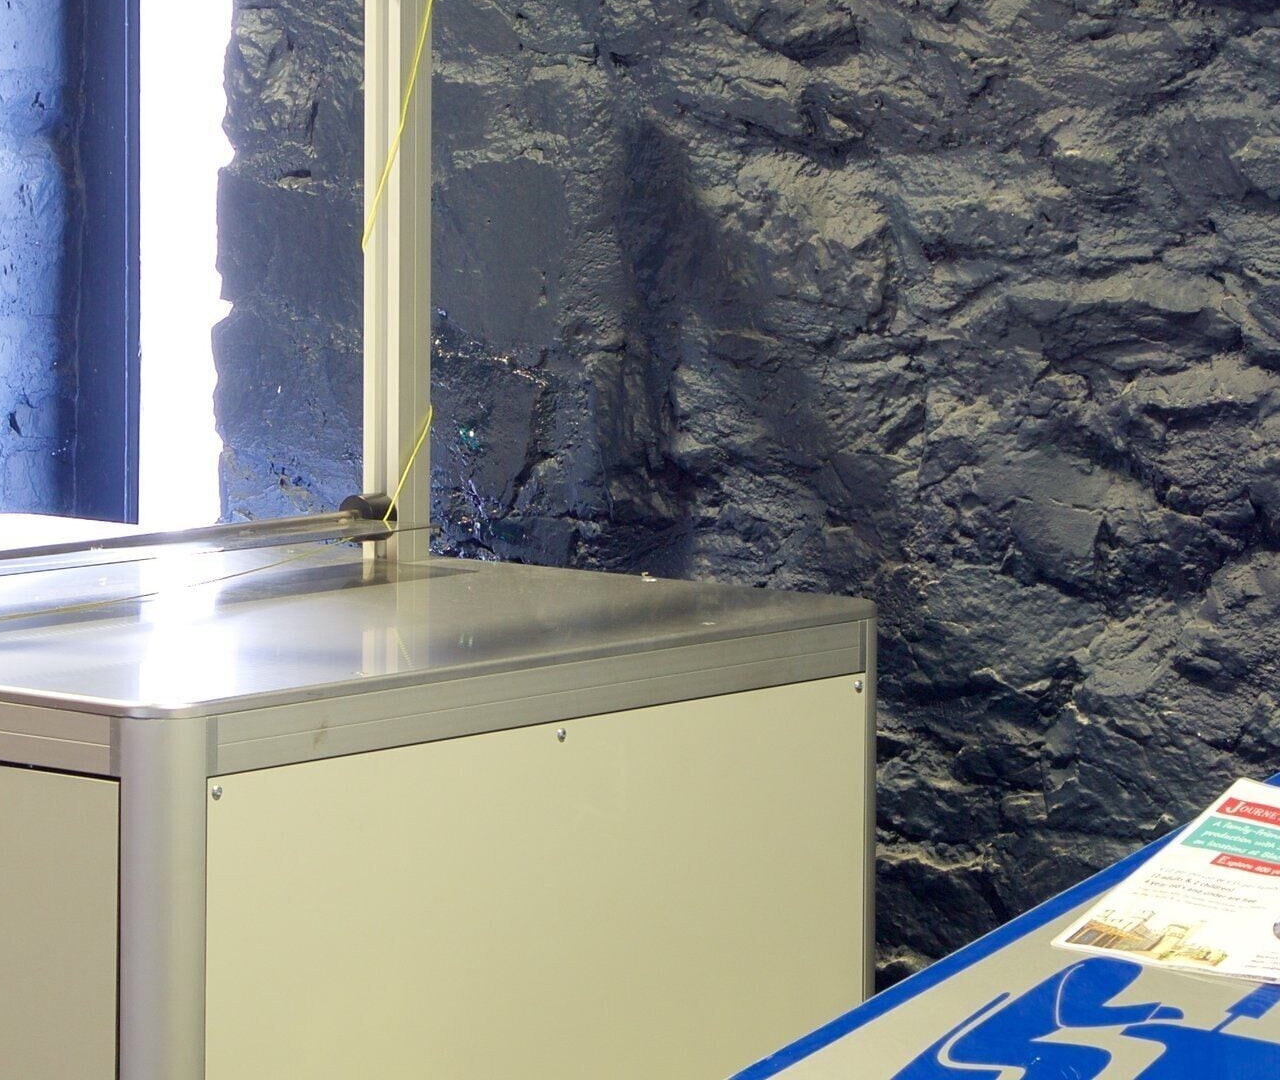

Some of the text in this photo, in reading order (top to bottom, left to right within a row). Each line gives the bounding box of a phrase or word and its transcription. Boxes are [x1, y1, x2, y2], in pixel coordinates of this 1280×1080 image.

[1201, 831, 1253, 845] production
[1254, 840, 1275, 850] with
[1216, 855, 1254, 870] Explore
[1254, 865, 1272, 873] 400
